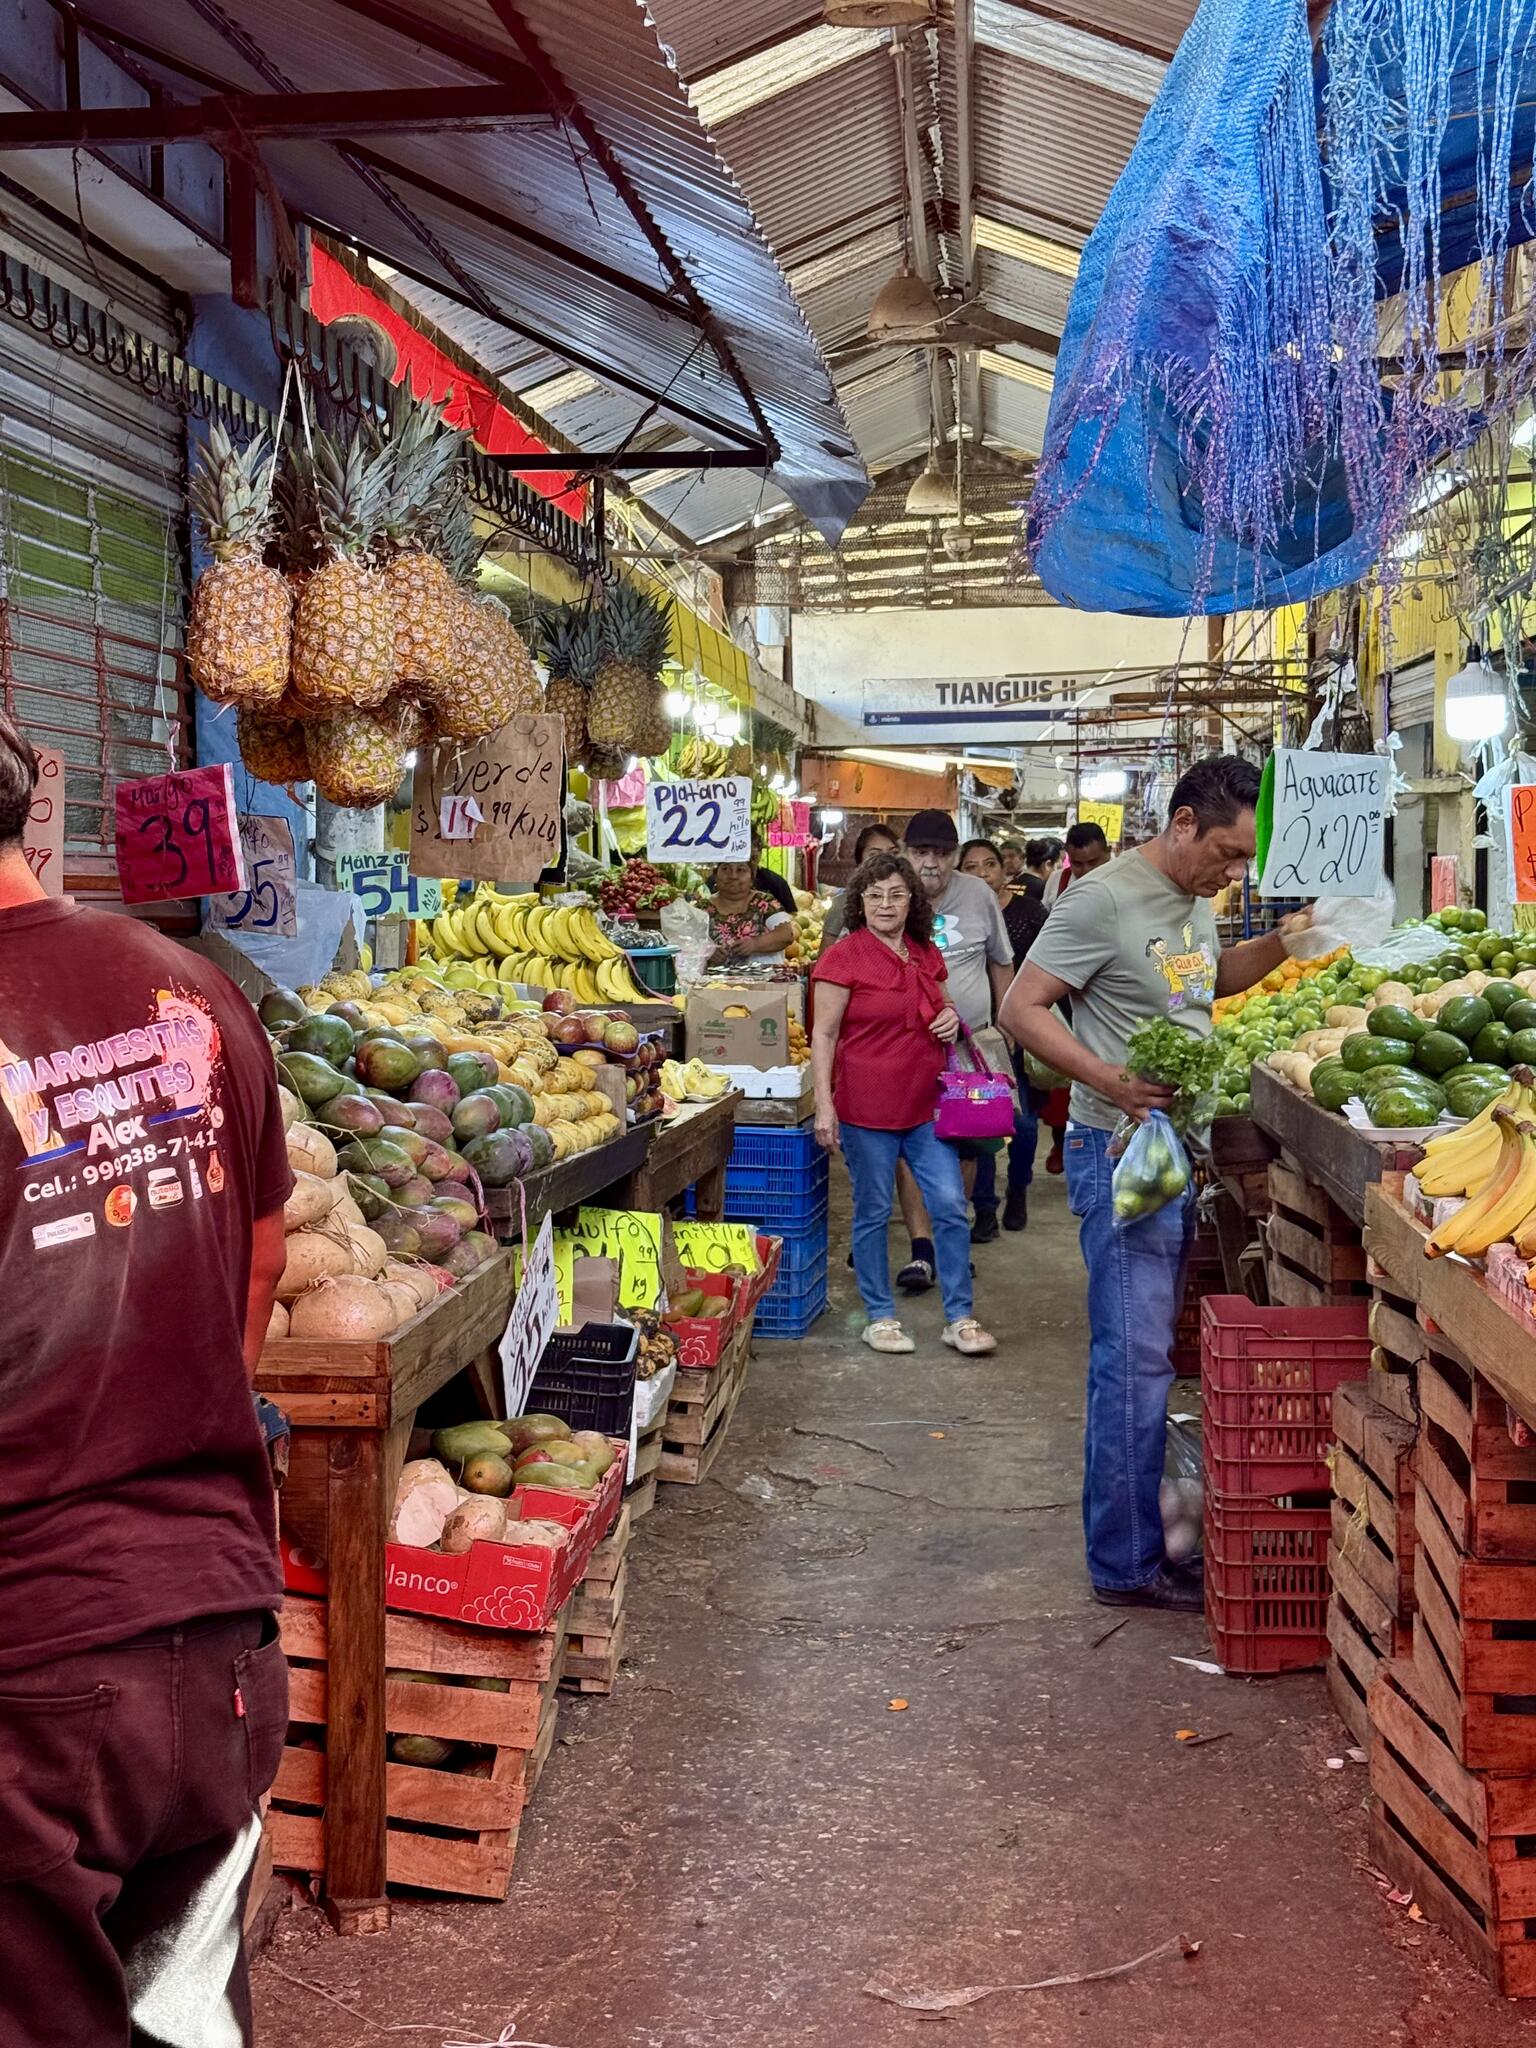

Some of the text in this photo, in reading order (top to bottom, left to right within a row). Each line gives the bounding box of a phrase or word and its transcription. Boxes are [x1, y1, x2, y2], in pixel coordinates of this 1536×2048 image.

[936, 680, 1052, 704] TIANGUIS
[654, 781, 737, 811] Platano
[138, 797, 218, 890] 39
[661, 801, 730, 849] 22
[353, 866, 419, 917] 54
[1, 1015, 203, 1098] MARQUESITAS
[54, 1058, 194, 1130] ESQUITES
[87, 1115, 148, 1156] Alex
[385, 1563, 450, 1594] lanco
